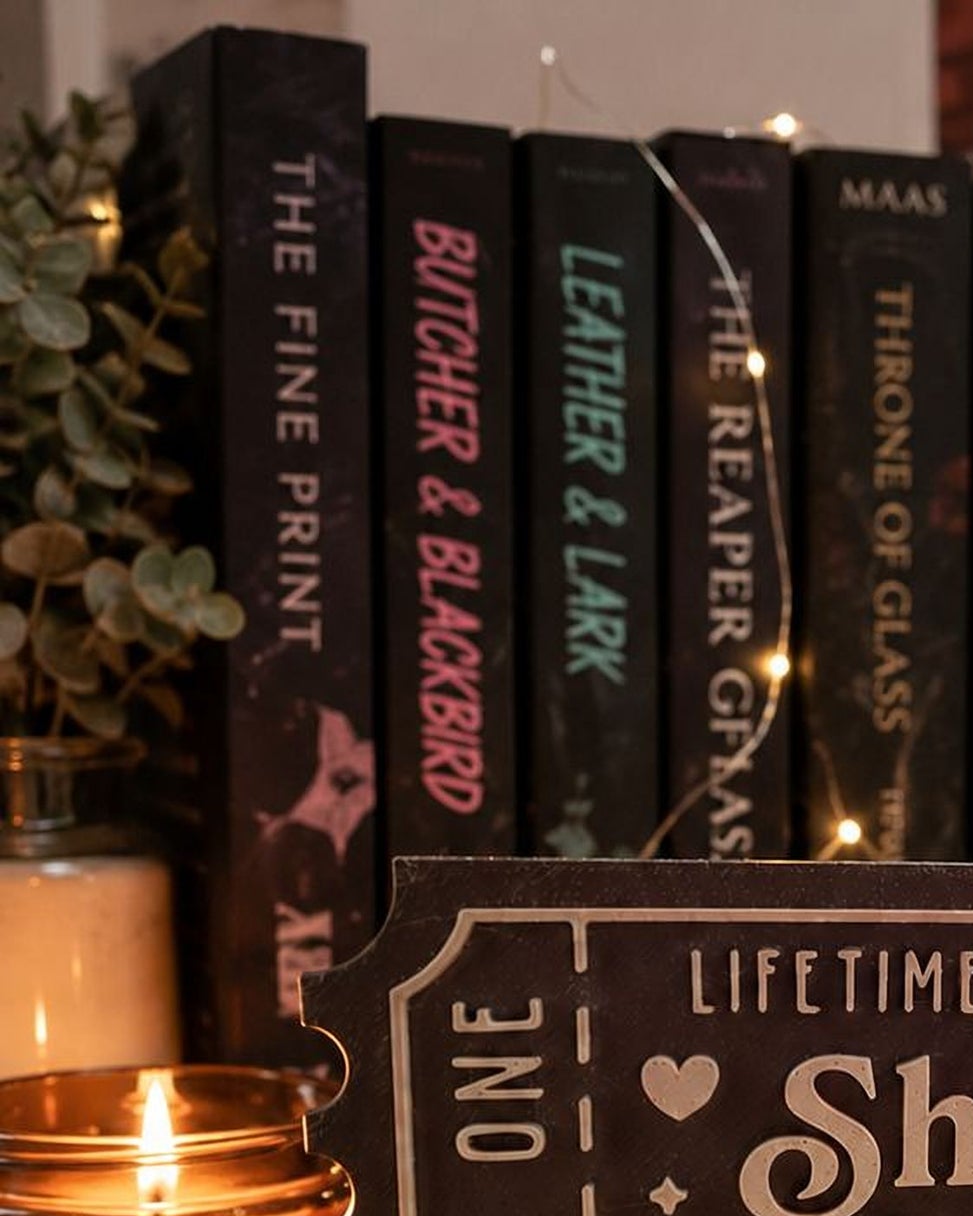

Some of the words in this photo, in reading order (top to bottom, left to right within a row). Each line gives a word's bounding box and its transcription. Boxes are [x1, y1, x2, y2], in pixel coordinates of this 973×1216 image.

[273, 153, 316, 276] THE
[839, 177, 946, 217] MAAS
[274, 302, 319, 445] FINE
[411, 217, 482, 464] BUTCHER
[560, 245, 626, 473] LEATHER
[709, 268, 750, 381] THE
[873, 282, 913, 490] THRONE
[276, 475, 325, 650] PRINT
[418, 475, 482, 519] &
[565, 485, 625, 528] &
[708, 404, 753, 645] REAPER
[873, 502, 912, 568] OF
[418, 534, 486, 815] BLACKBIRD
[565, 548, 626, 684] LARK
[872, 580, 912, 733] GLASS
[451, 997, 547, 1163] ONE
